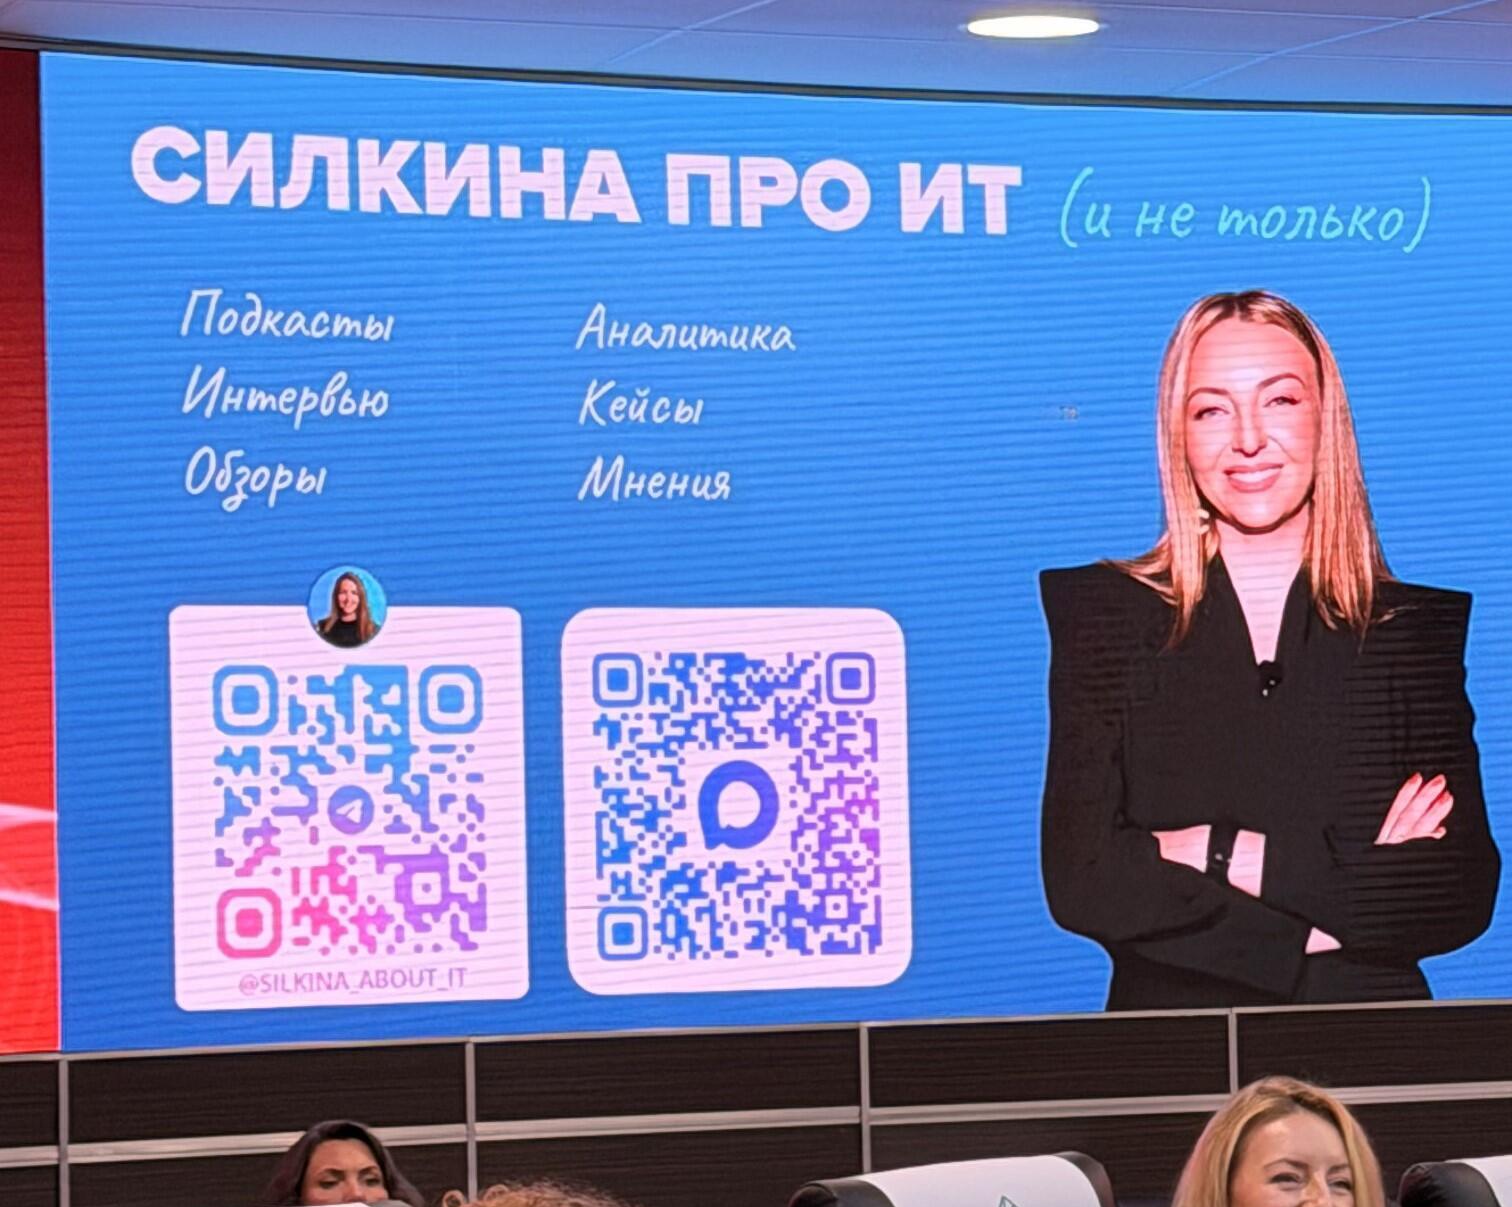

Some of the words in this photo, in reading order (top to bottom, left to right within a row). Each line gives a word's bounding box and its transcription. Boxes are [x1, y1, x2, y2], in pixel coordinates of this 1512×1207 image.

[131, 124, 642, 224] СИЛКИНА
[664, 152, 872, 232] ПРО
[899, 161, 1023, 236] ИТ
[1135, 200, 1195, 239] не
[180, 288, 395, 343] Подкасты
[575, 302, 797, 353] Аналитика
[181, 364, 390, 430] Интервью
[578, 379, 704, 427] Кейсы
[183, 446, 327, 512] Обзоры
[577, 455, 732, 502] Мнения
[238, 967, 468, 996] @SILKINA_ABOUT_IT
